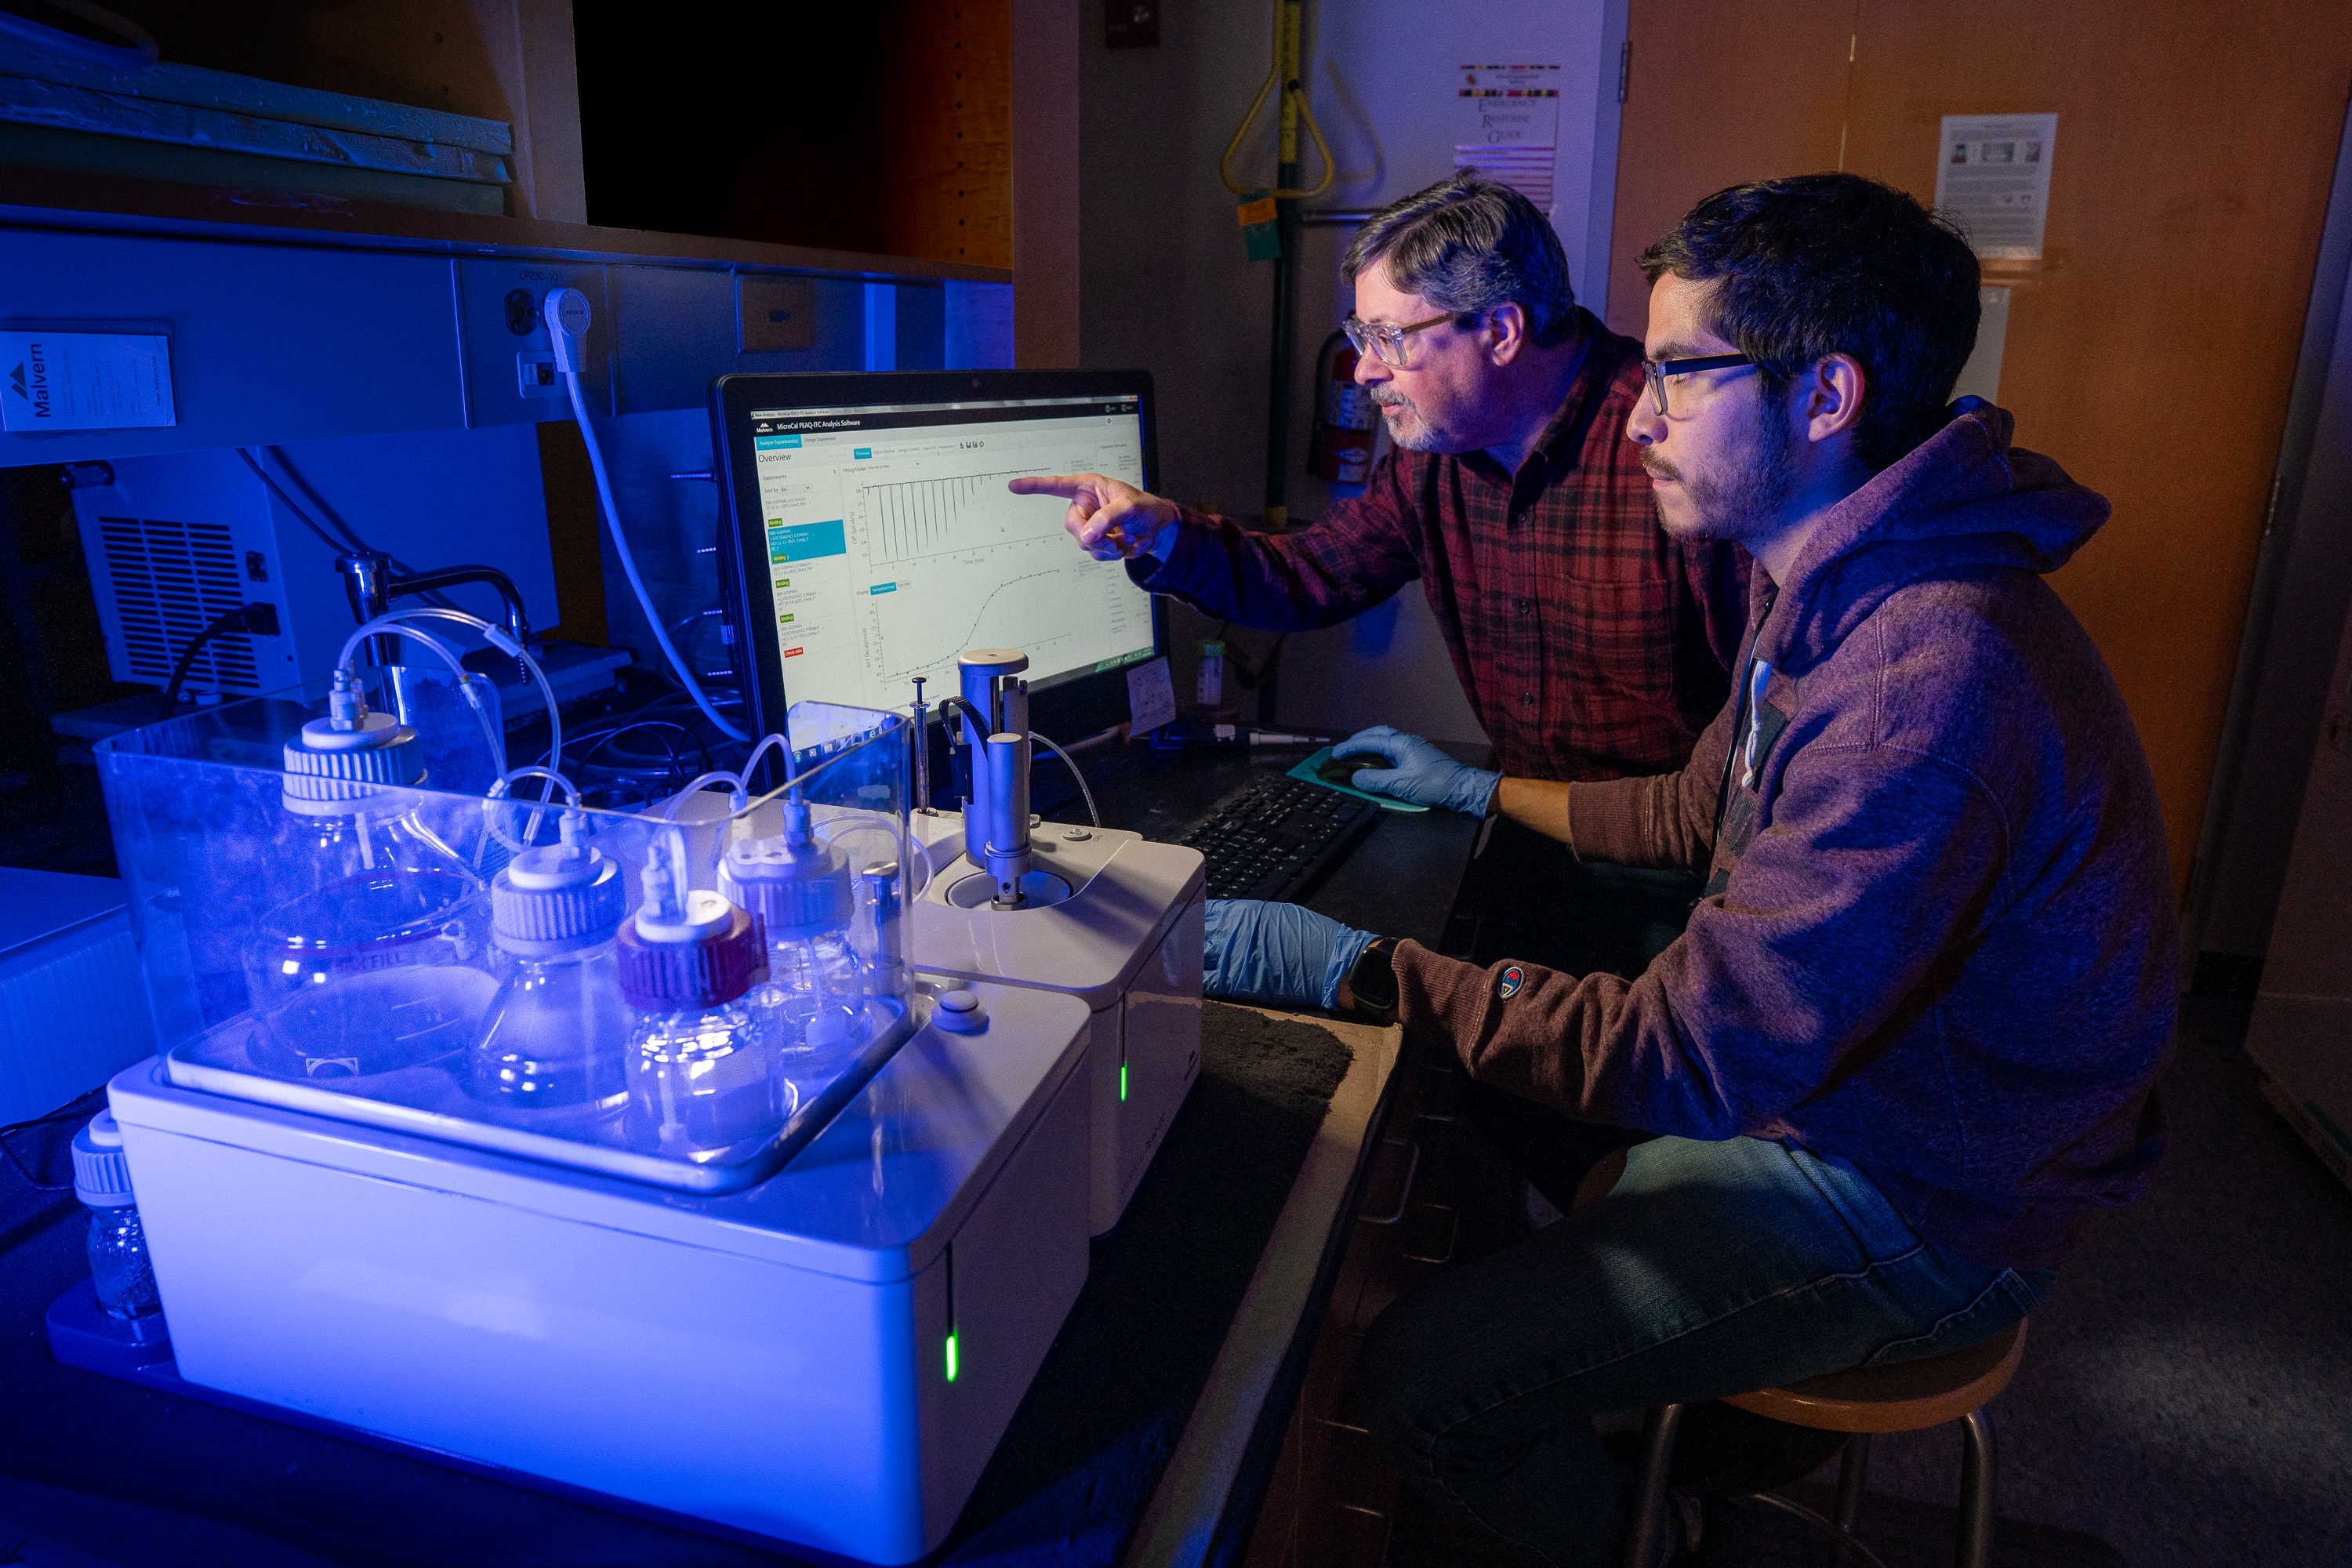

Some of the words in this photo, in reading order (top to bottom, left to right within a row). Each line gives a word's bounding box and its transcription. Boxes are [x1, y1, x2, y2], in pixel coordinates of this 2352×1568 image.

[519, 270, 557, 281] LP23C-10
[30, 343, 51, 418] Malvern
[152, 355, 161, 406] www.malvern.com
[822, 419, 840, 428] Analysis
[758, 452, 792, 463] Overview
[851, 535, 857, 544] DP
[372, 951, 405, 970] FILL
